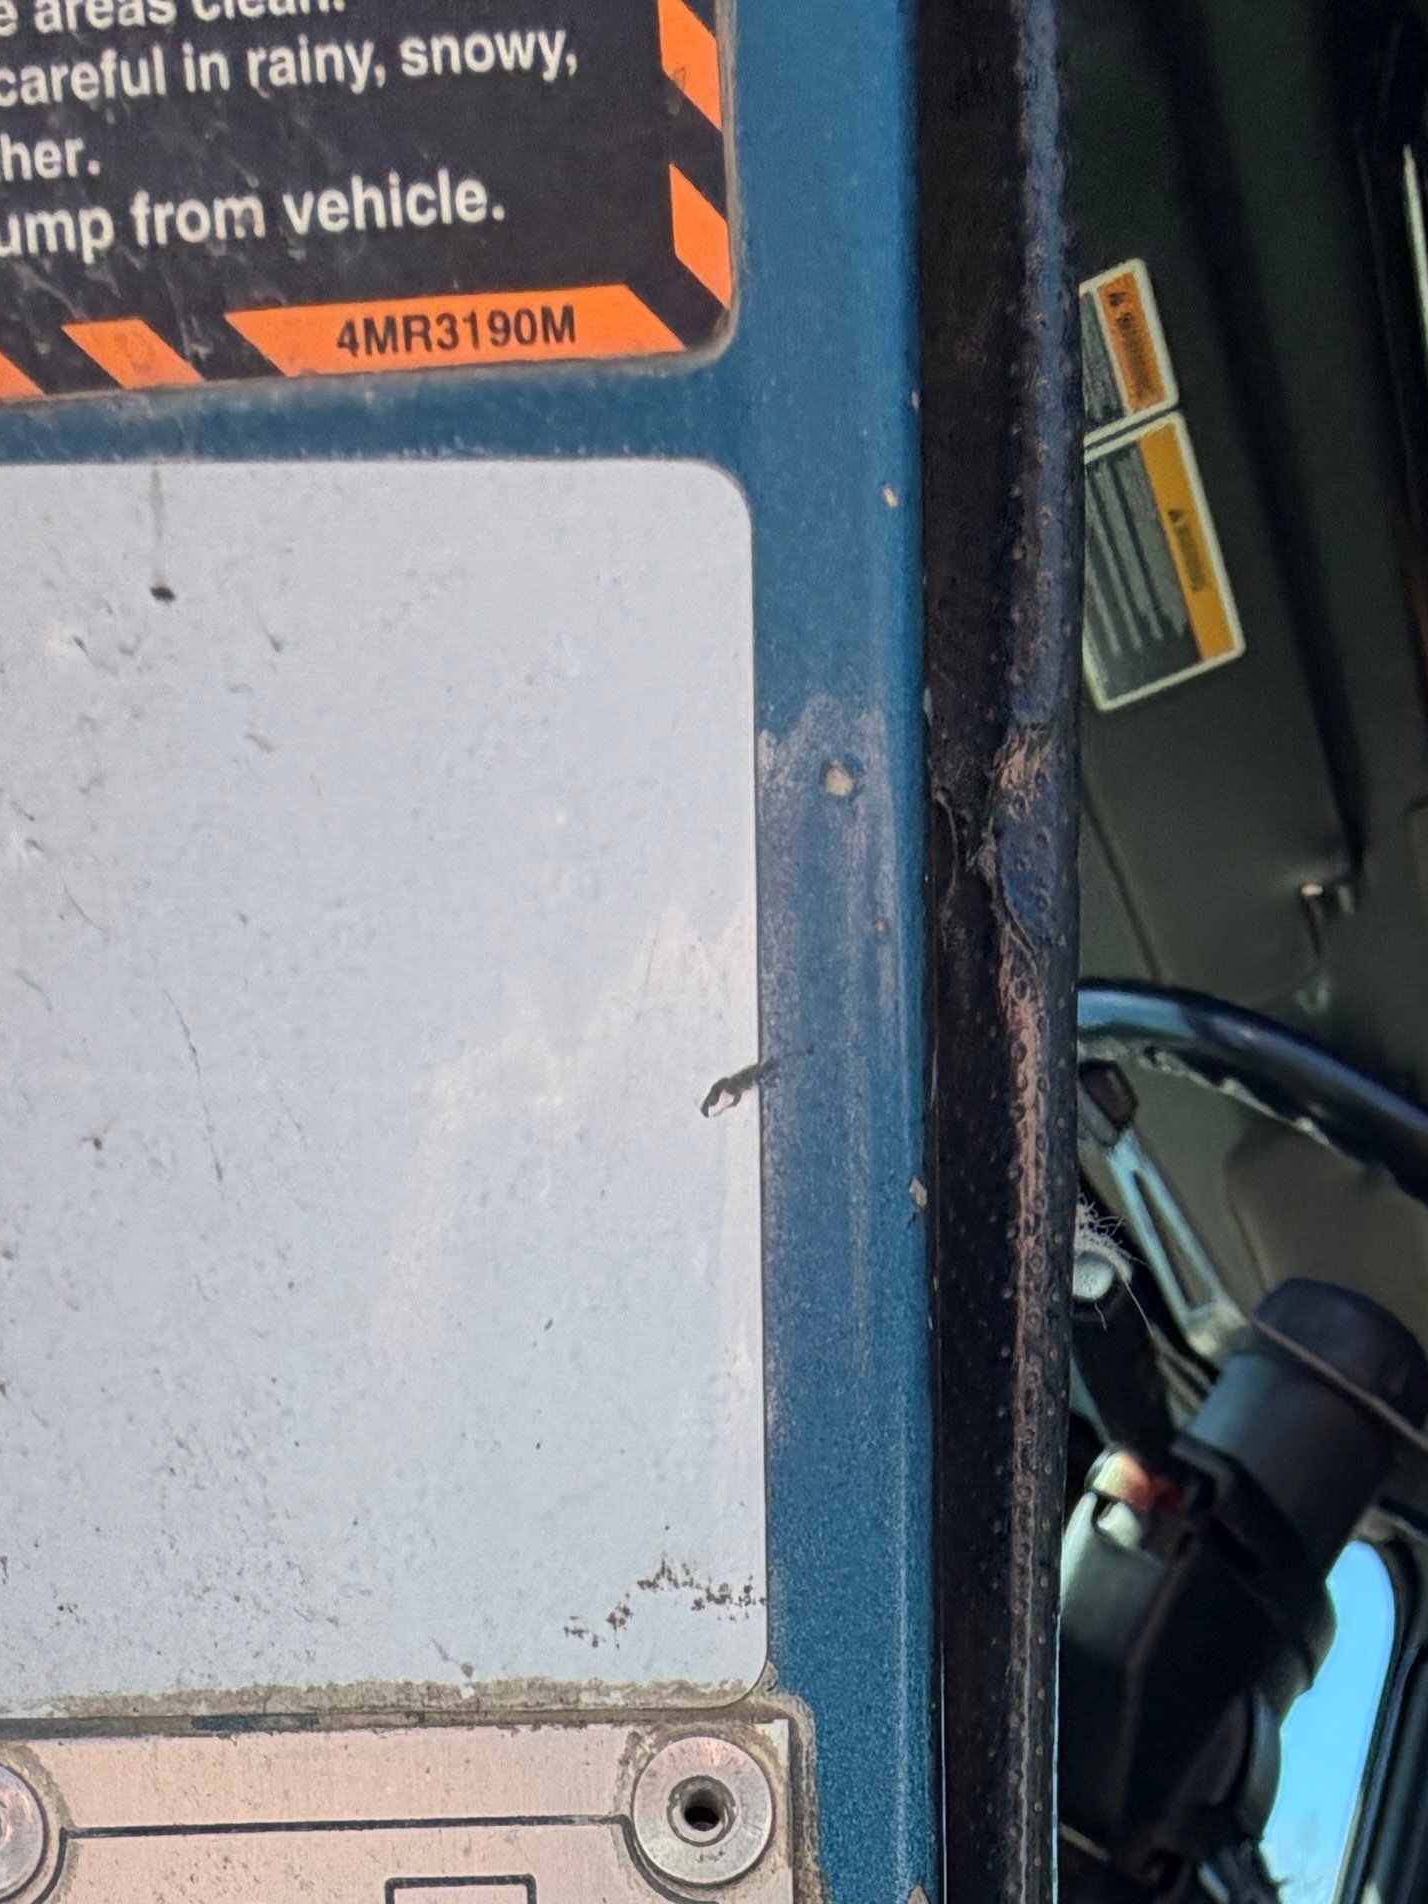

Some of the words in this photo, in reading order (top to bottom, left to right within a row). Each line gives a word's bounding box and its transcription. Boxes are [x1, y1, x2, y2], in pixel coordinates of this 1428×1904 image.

[33, 0, 177, 34] areas
[182, 40, 231, 93] in
[246, 33, 387, 96] rainy,
[399, 28, 578, 84] snowy,
[129, 187, 266, 248] from
[282, 166, 506, 237] vehicle.
[335, 303, 577, 358] 4MR3190M
